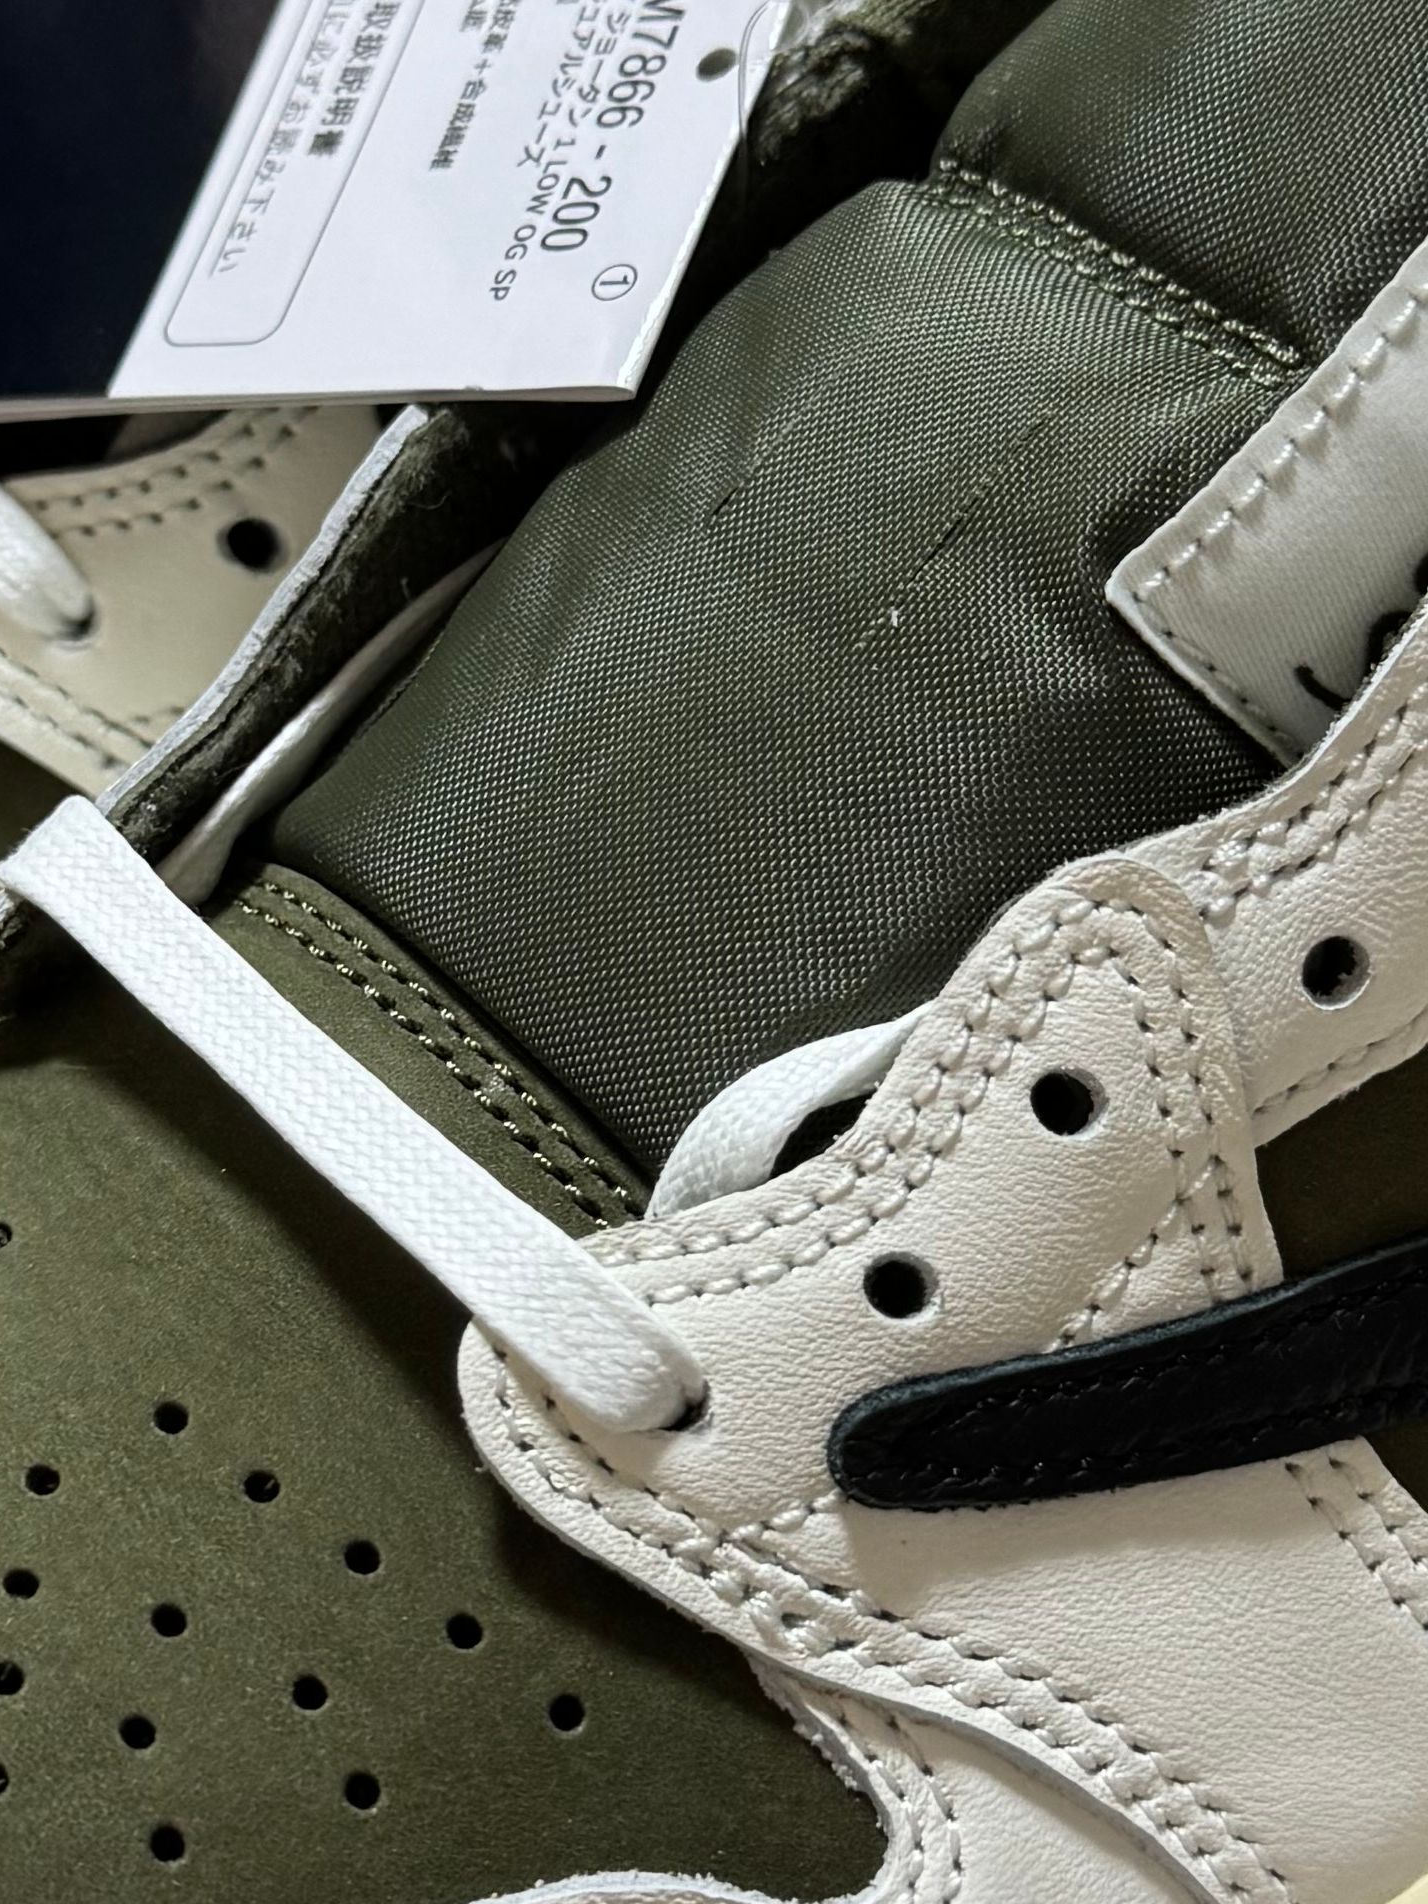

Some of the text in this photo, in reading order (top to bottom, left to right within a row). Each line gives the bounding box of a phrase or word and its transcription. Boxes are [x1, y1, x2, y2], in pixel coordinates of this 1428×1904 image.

[524, 158, 568, 216] LOW
[538, 174, 613, 252] 200
[503, 222, 538, 261] OG
[487, 267, 518, 302] SP
